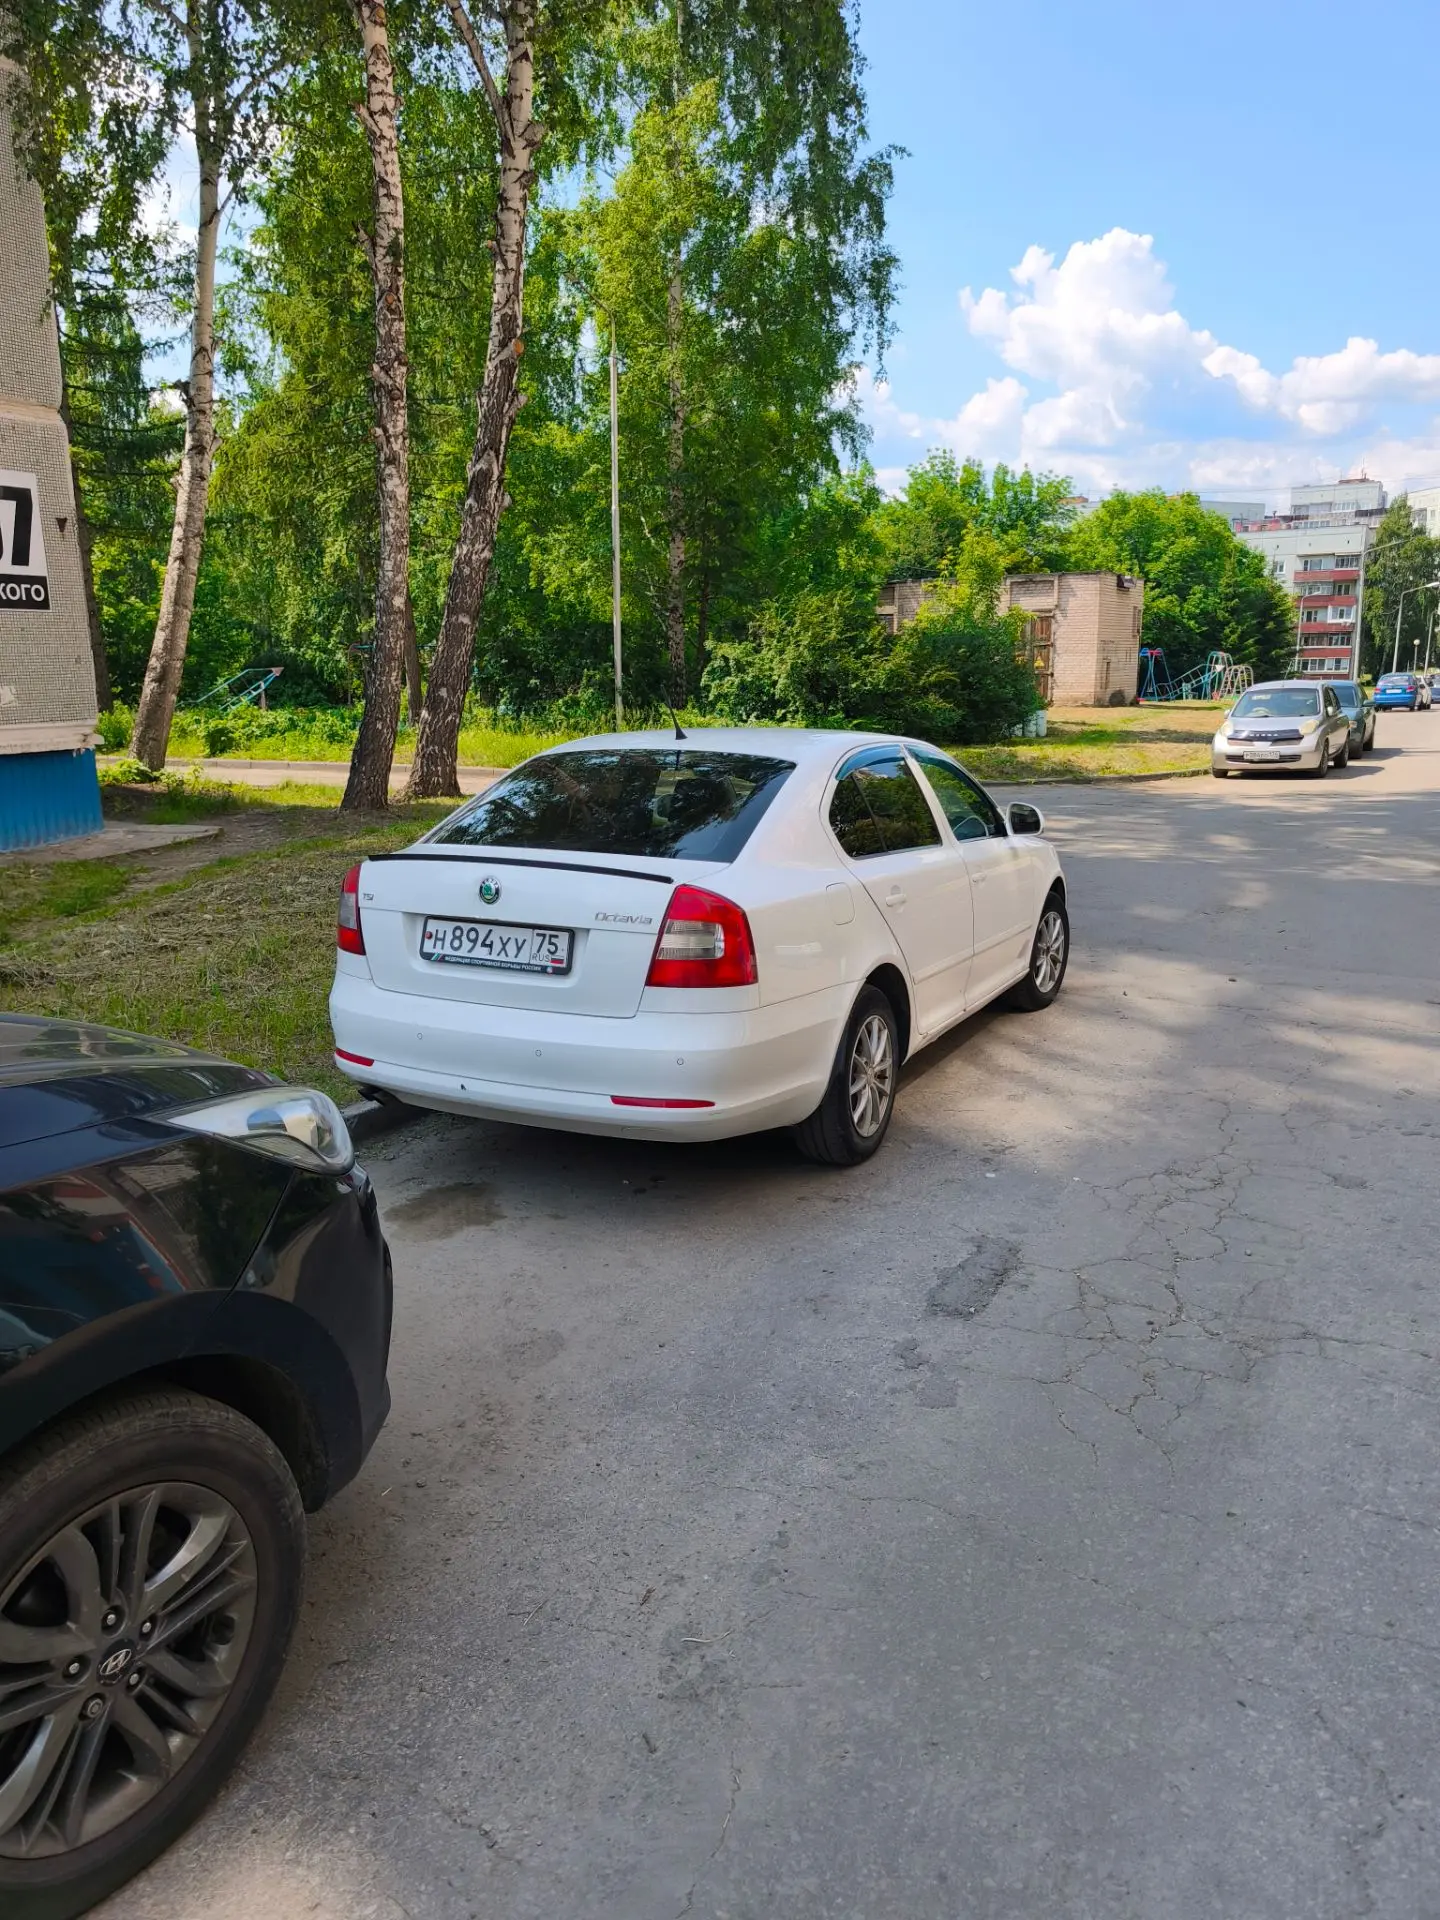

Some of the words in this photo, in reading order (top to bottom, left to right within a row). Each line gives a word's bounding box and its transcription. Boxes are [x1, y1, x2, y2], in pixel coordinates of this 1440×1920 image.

[0, 485, 33, 566] 7
[595, 911, 653, 925] Octavia
[536, 933, 559, 956] 75
[532, 953, 550, 962] RUS
